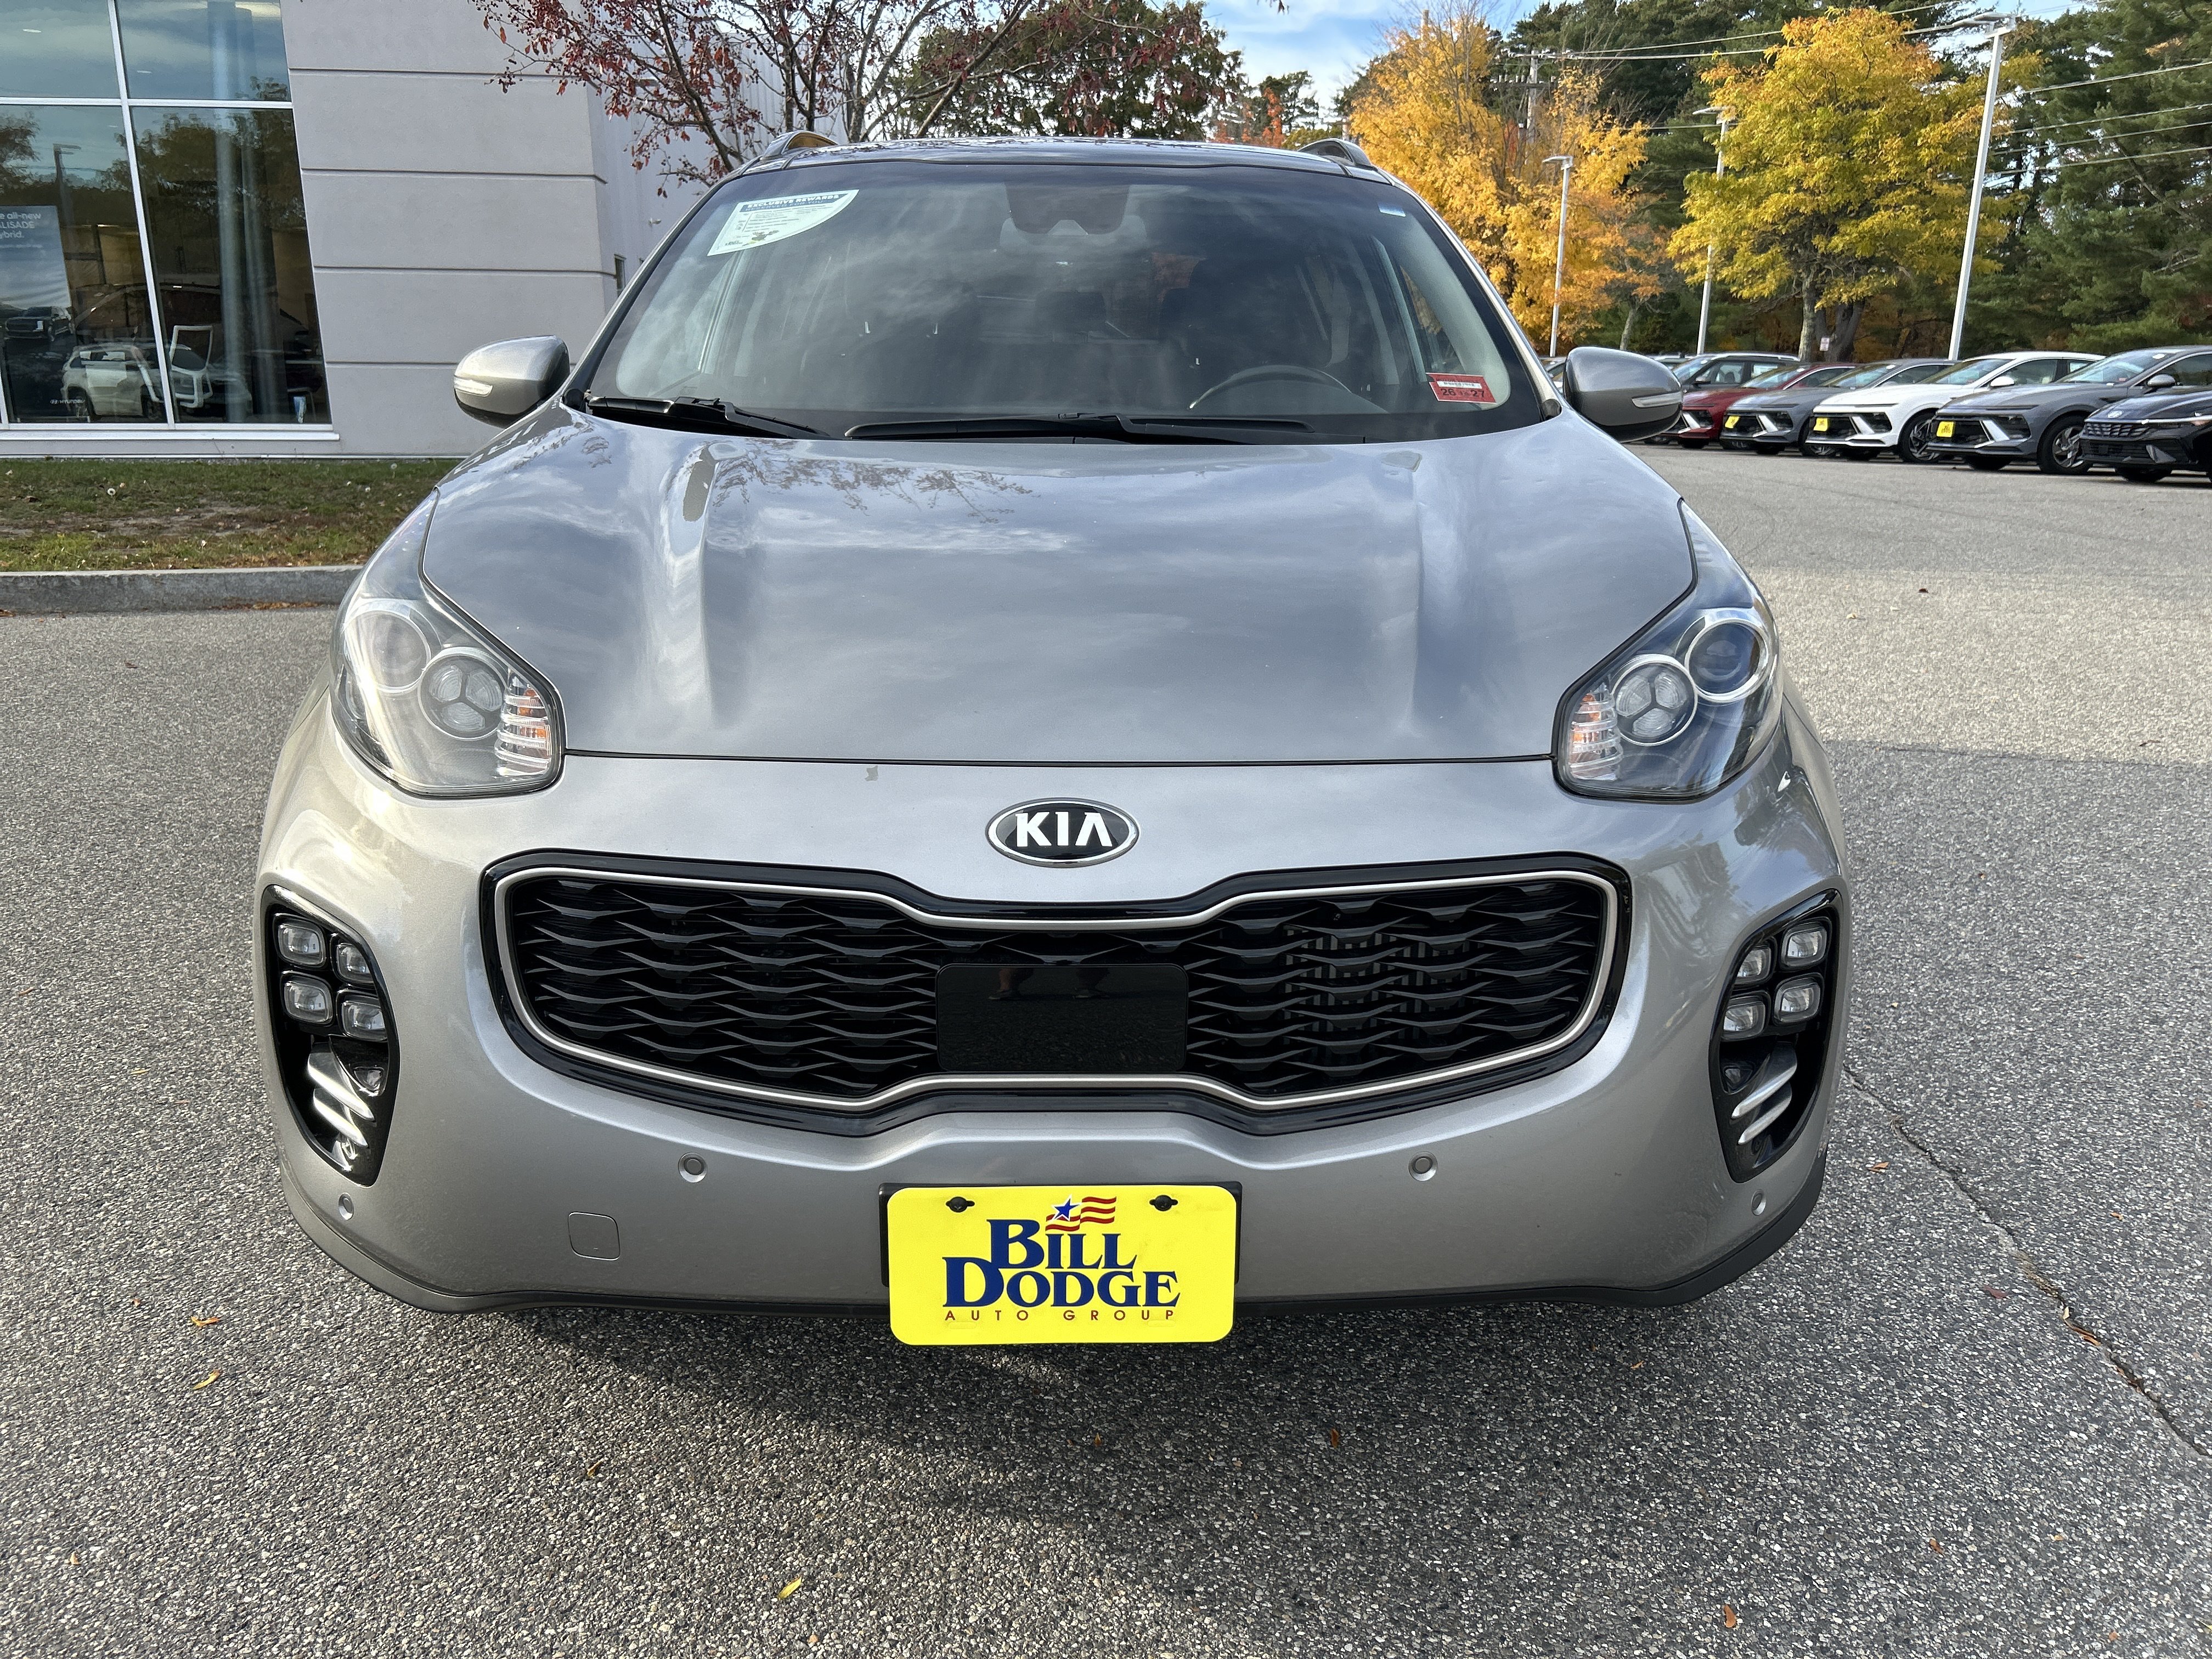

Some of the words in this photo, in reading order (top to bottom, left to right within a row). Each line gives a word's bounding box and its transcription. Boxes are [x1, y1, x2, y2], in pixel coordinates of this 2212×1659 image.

[747, 199, 793, 208] EXCLUSIVE
[795, 194, 839, 202] REWARDS
[1015, 811, 1113, 847] KIA
[986, 1218, 1138, 1269] BILL
[942, 1256, 1181, 1308] DODGE
[945, 1310, 1029, 1321] AUTO
[1063, 1310, 1175, 1321] GROUP
